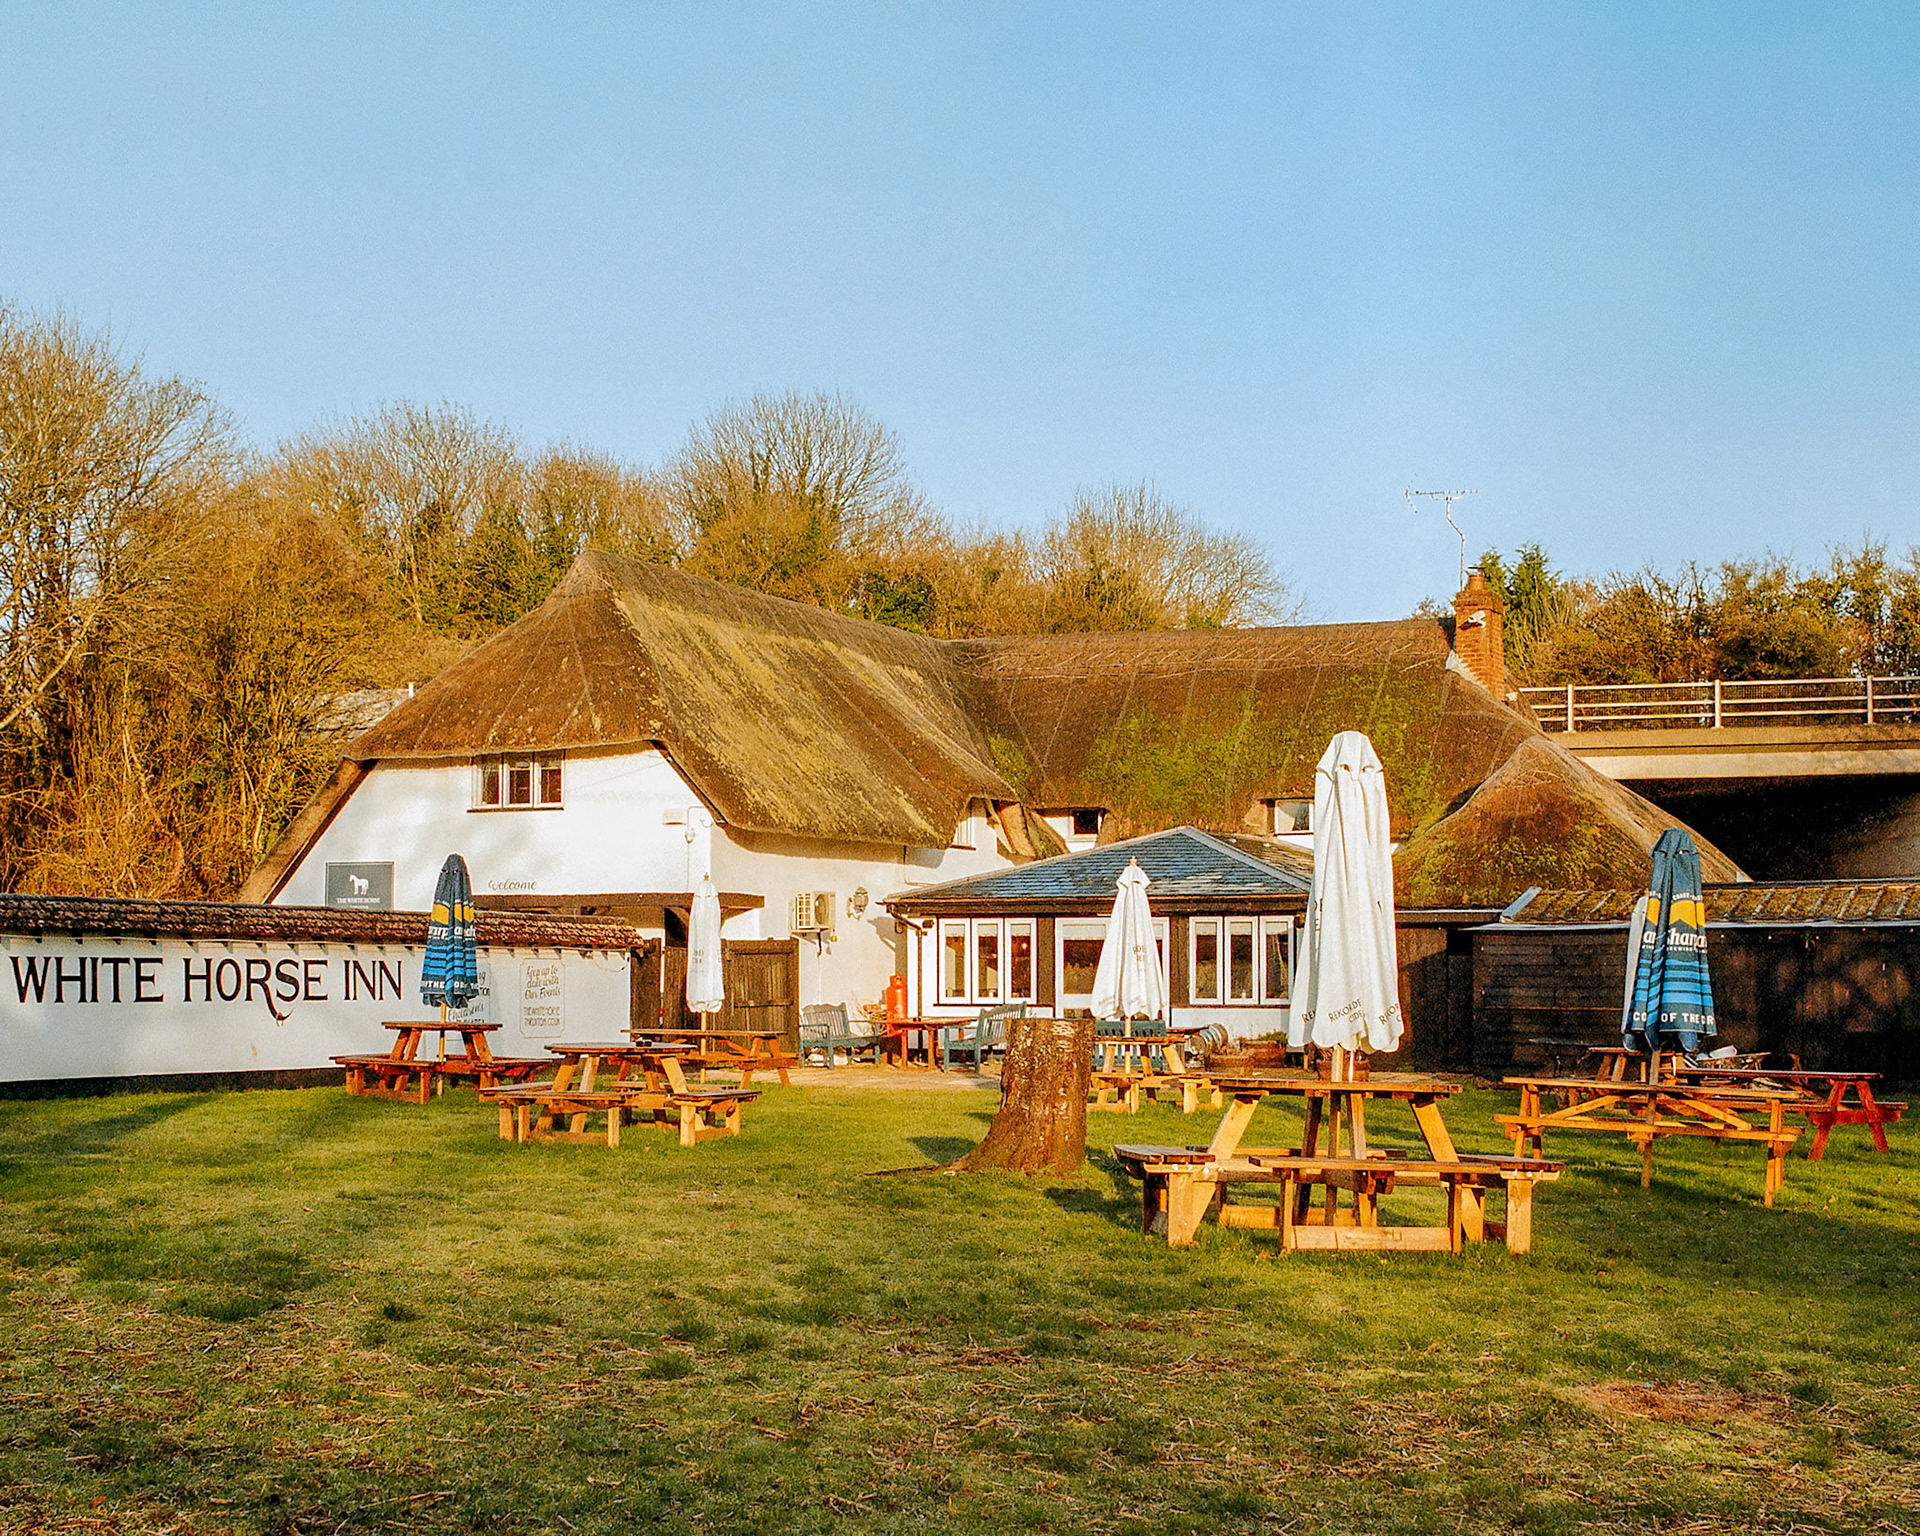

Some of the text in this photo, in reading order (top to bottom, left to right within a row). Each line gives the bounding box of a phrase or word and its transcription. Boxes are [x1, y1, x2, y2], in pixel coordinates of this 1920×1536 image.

[9, 956, 402, 1027] WHITE HORSE INN
[1660, 1012, 1677, 1023] OF
